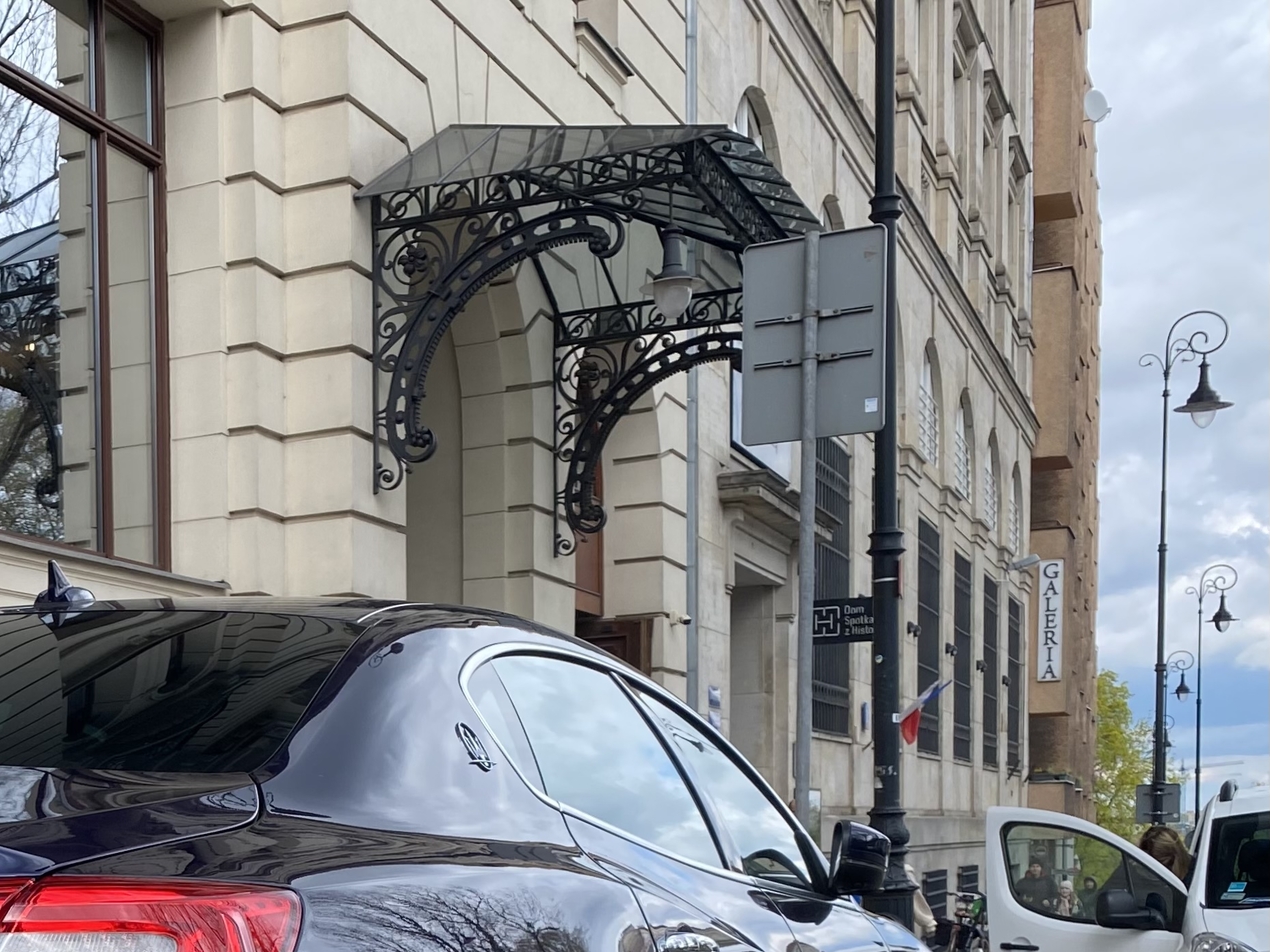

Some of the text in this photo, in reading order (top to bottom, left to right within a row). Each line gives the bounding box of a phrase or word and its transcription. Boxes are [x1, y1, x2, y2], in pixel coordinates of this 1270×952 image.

[843, 604, 865, 615] Dom
[1041, 563, 1060, 679] GALERIA
[843, 628, 851, 636] z
